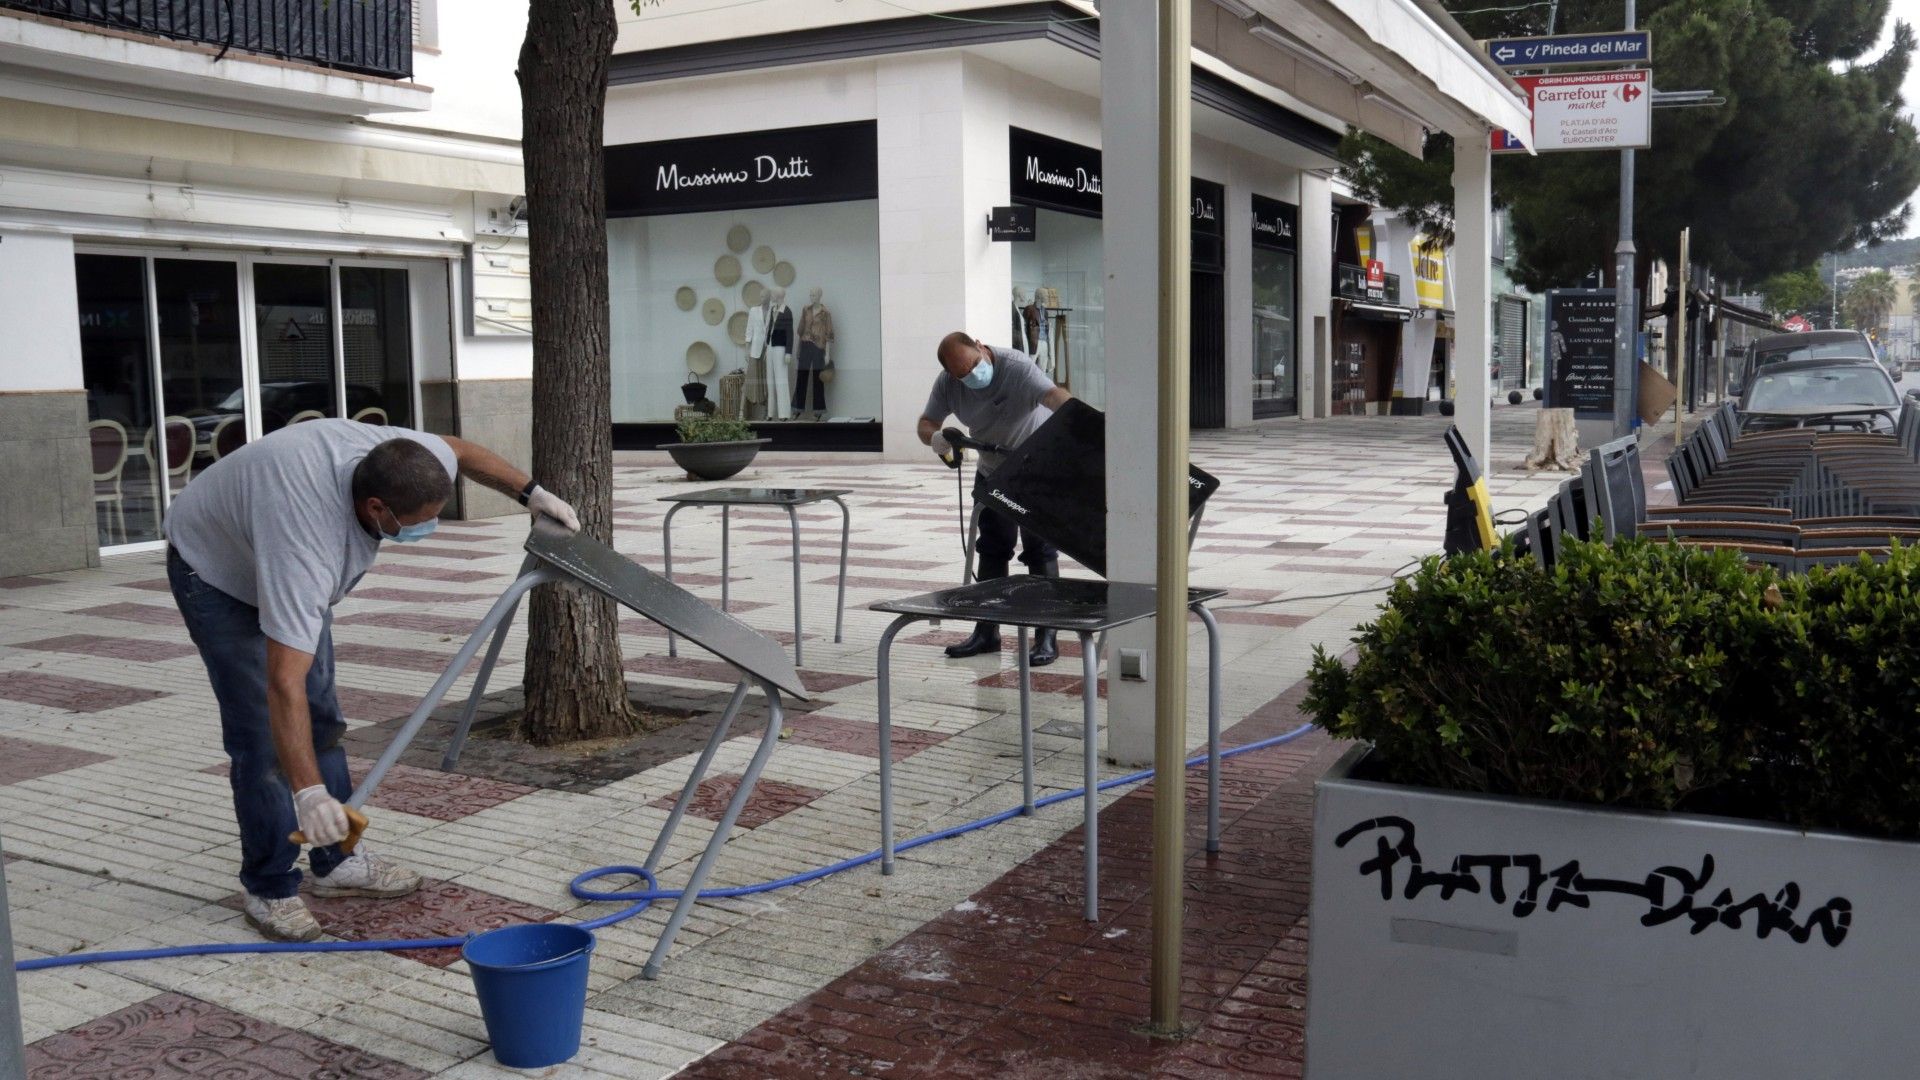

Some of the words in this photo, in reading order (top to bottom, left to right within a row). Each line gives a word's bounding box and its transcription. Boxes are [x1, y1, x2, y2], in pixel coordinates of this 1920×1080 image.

[1525, 45, 1539, 59] c/
[1541, 43, 1588, 56] Pineda
[1590, 42, 1611, 54] del
[1614, 41, 1642, 52] Mar
[1538, 77, 1563, 85] OBRIM
[1563, 74, 1607, 83] DIUMENGES
[1611, 72, 1641, 81] FESTIUS
[1537, 88, 1607, 102] Carrefour
[1567, 100, 1606, 110] market
[1560, 119, 1591, 127] PLATJA
[1591, 117, 1618, 126] D'ARO
[1597, 127, 1618, 135] d'Aro
[1562, 135, 1615, 144] EUROCENTER
[656, 163, 748, 191] Massimo
[753, 154, 813, 183] Dutti
[1025, 155, 1075, 189] Massimo
[1075, 167, 1102, 195] Dutti
[988, 488, 1030, 515] Schweppes
